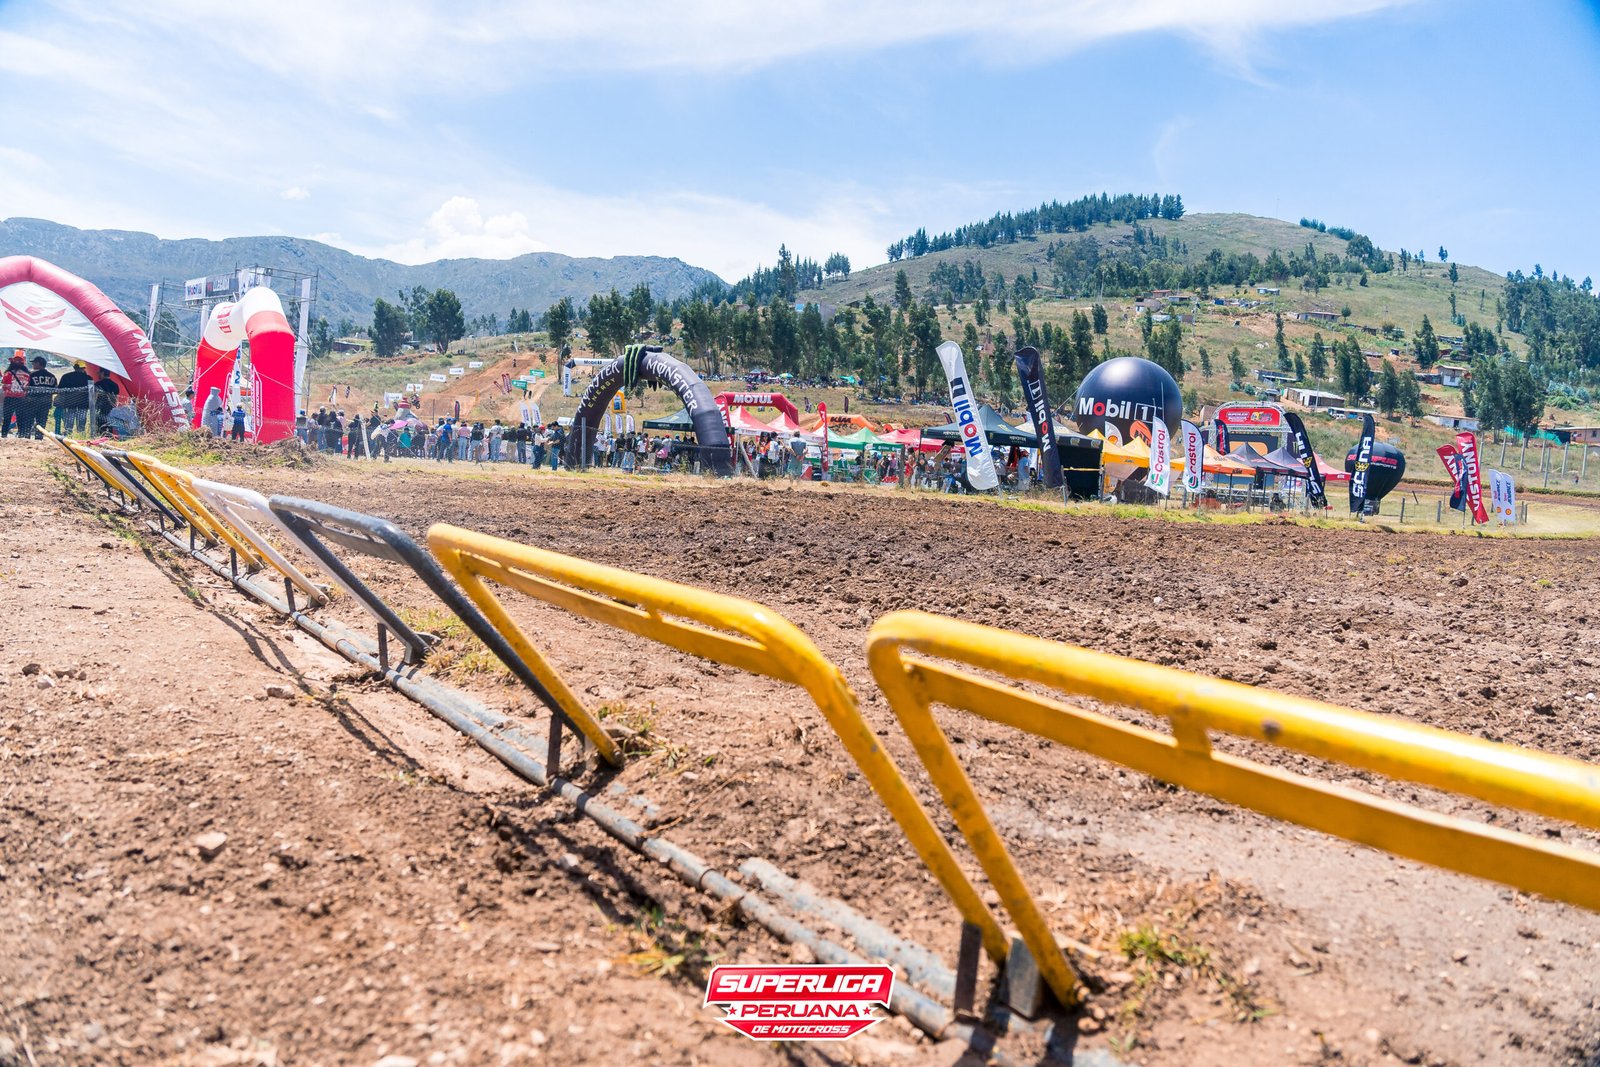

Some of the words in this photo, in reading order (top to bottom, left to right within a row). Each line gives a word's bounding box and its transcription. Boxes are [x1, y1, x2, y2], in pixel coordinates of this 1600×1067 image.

[132, 332, 190, 432] VISTONY
[646, 359, 698, 418] MONSTER
[734, 394, 773, 404] MOTUL
[1079, 397, 1132, 420] Mobil
[954, 399, 983, 458] Mobil
[1034, 399, 1051, 453] Mobil
[1155, 429, 1166, 472] Castrol
[1188, 432, 1197, 474] Castrol
[1460, 441, 1480, 512] VISTONY
